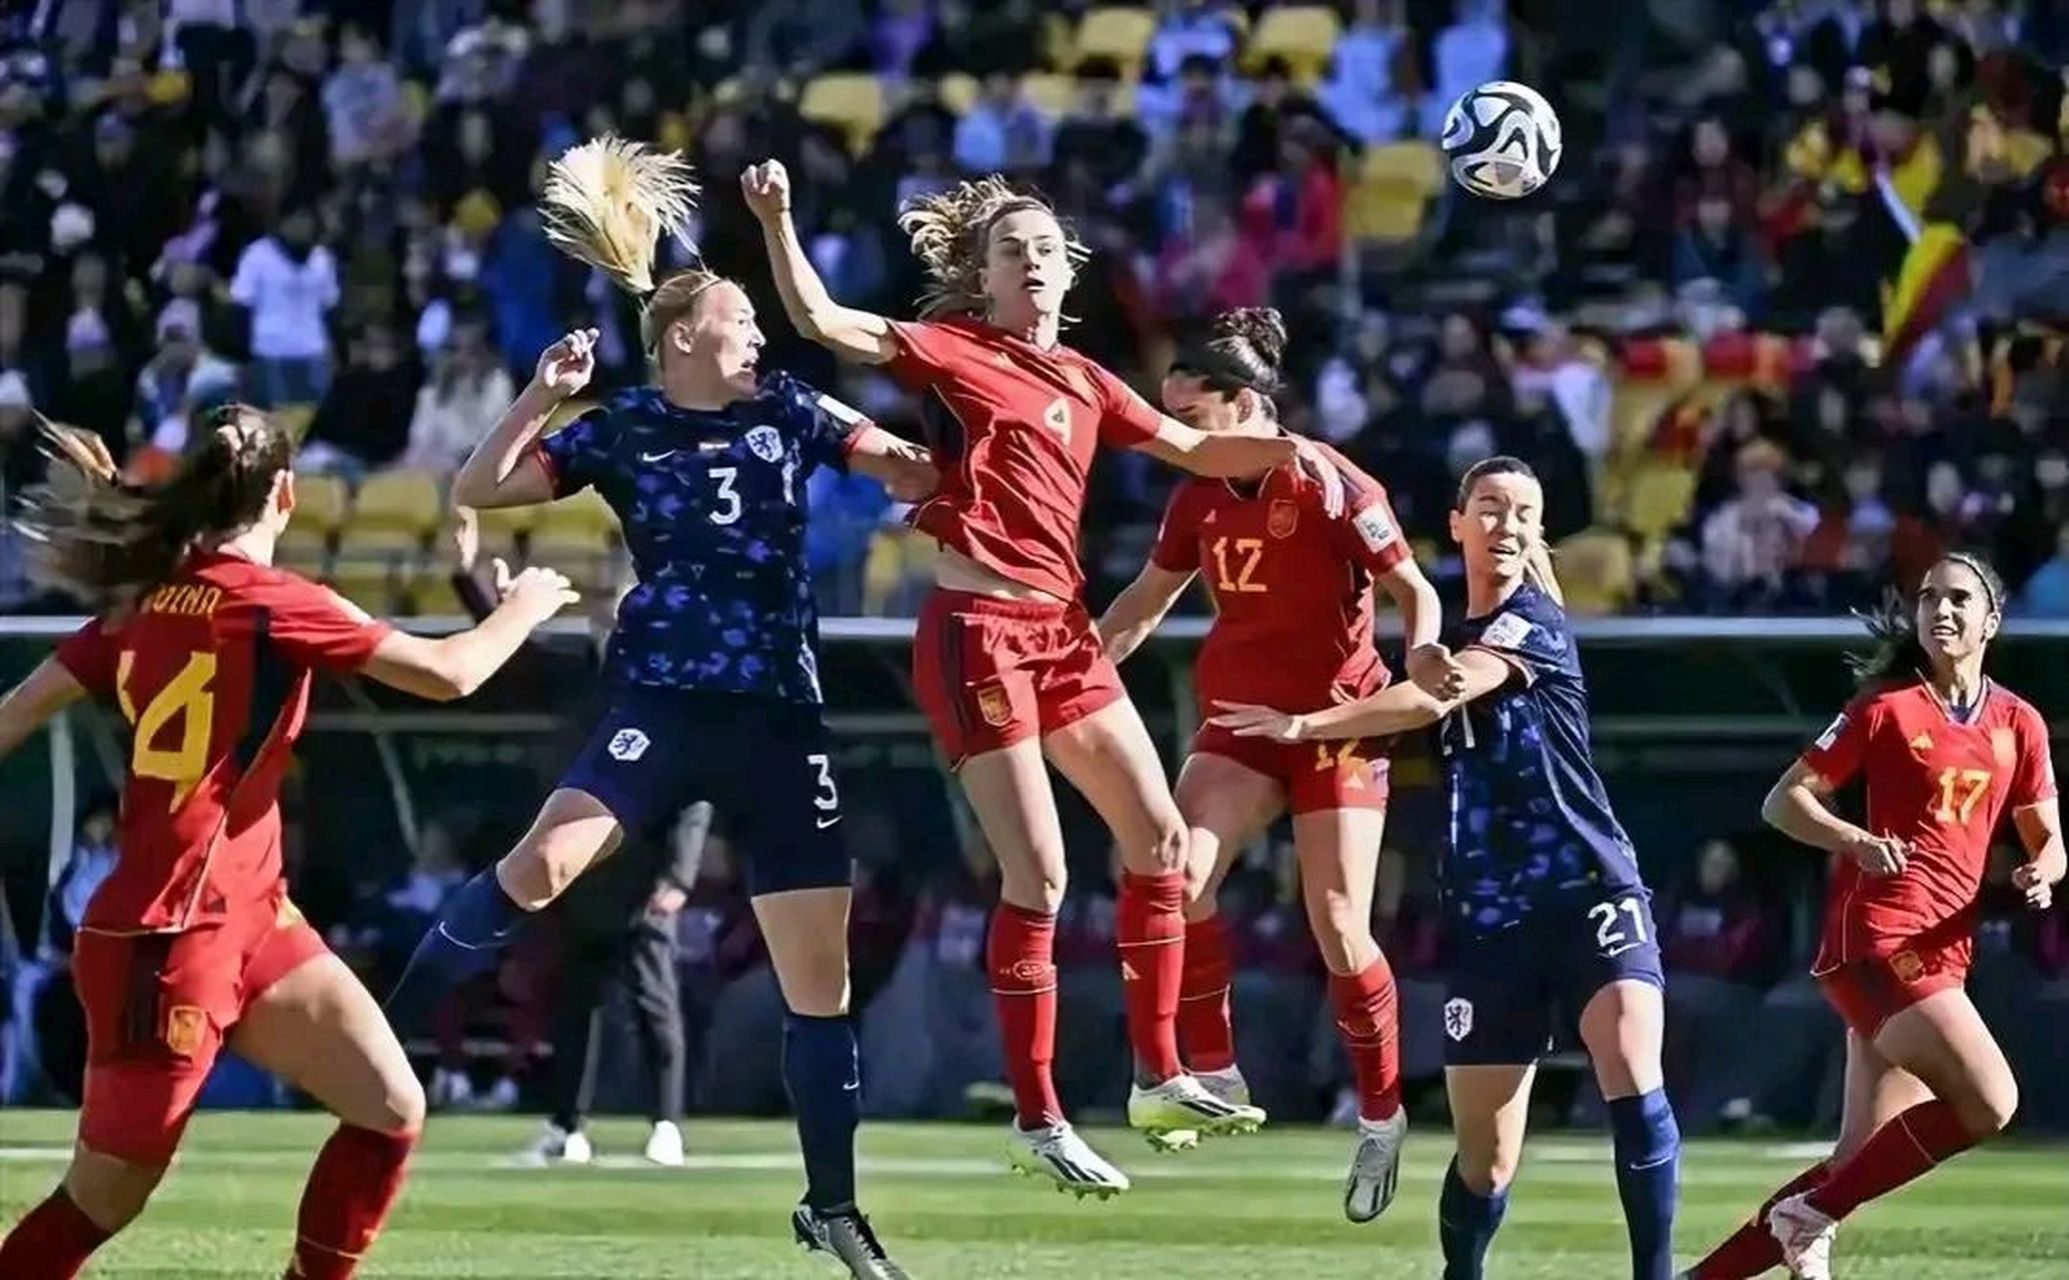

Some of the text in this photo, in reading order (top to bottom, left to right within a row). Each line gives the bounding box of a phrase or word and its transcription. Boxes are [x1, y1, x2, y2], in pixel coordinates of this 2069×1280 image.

[1043, 397, 1072, 447] 9
[709, 467, 741, 525] 3
[1212, 536, 1268, 592] 12
[116, 650, 216, 815] 14
[807, 754, 838, 810] 3
[1935, 766, 1991, 824] 17
[1588, 897, 1648, 948] 21
